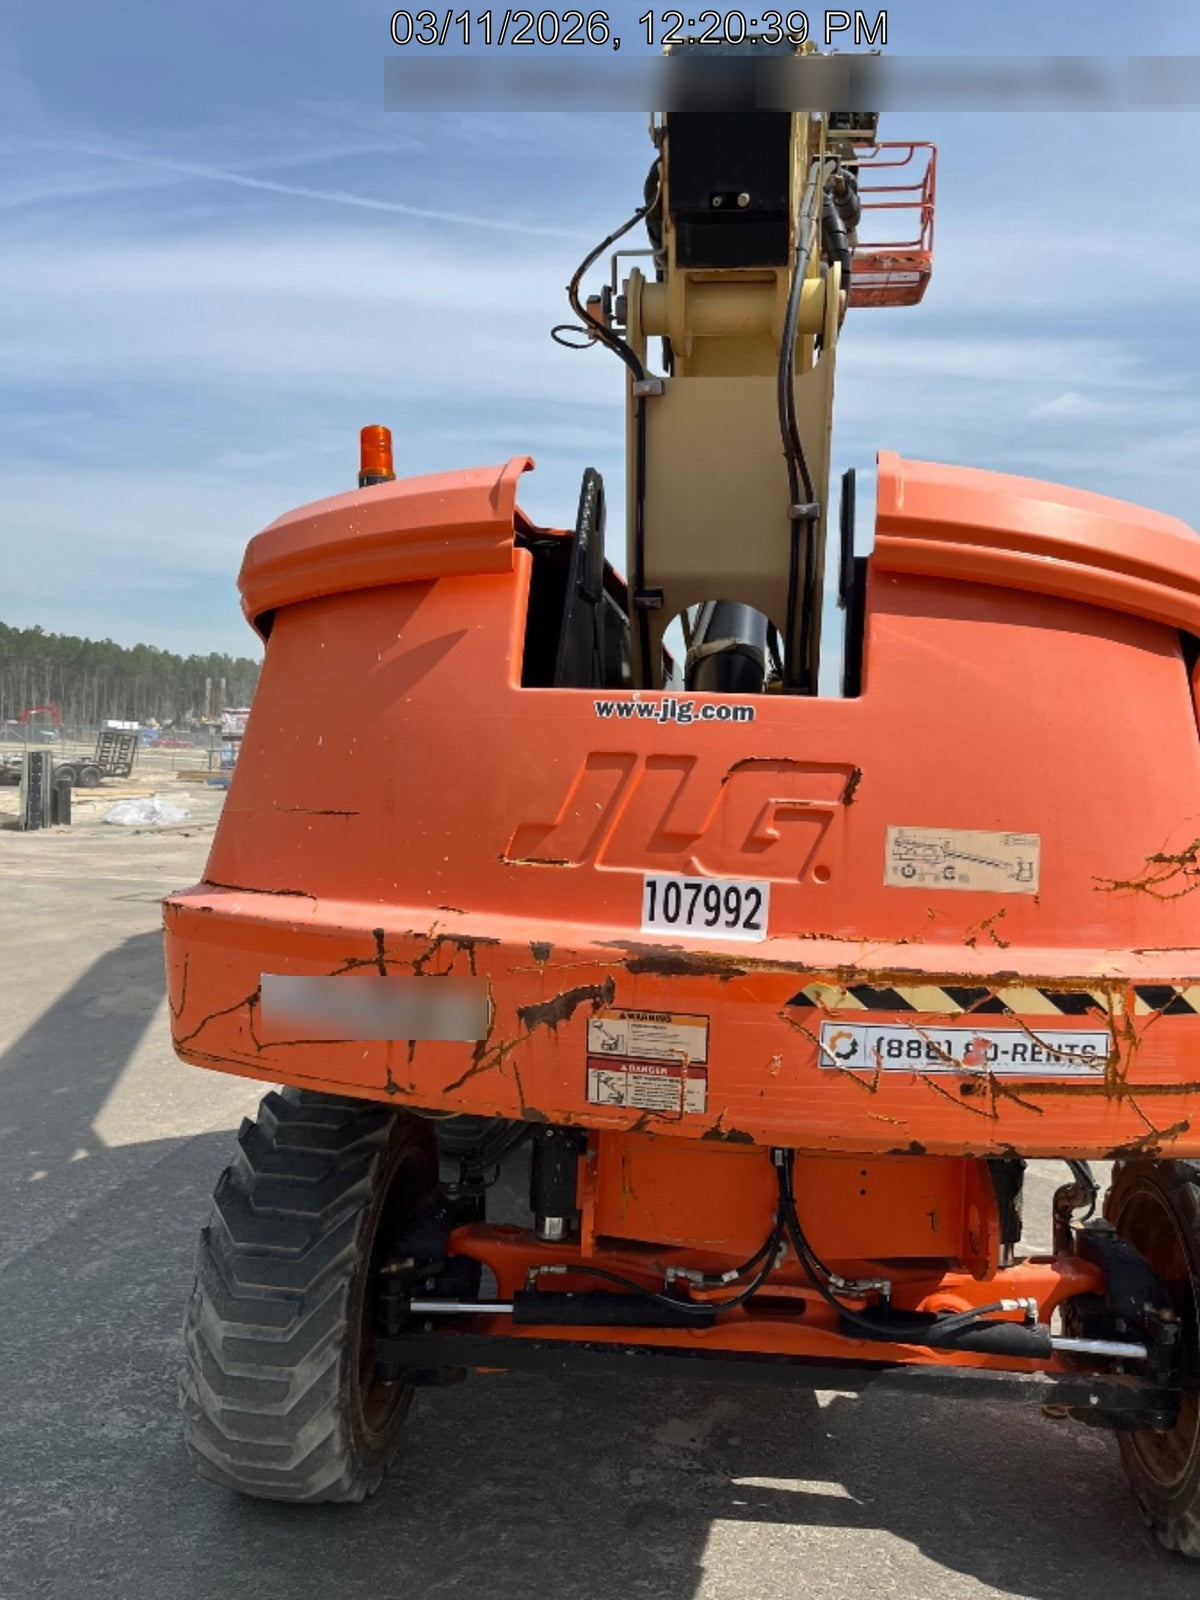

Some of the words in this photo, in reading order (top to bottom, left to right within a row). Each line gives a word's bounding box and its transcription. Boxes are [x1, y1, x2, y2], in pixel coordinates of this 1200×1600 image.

[594, 698, 756, 723] www.jlg.com
[645, 880, 763, 930] 107992
[627, 1012, 672, 1023] WARNING
[628, 1063, 668, 1075] DANGER
